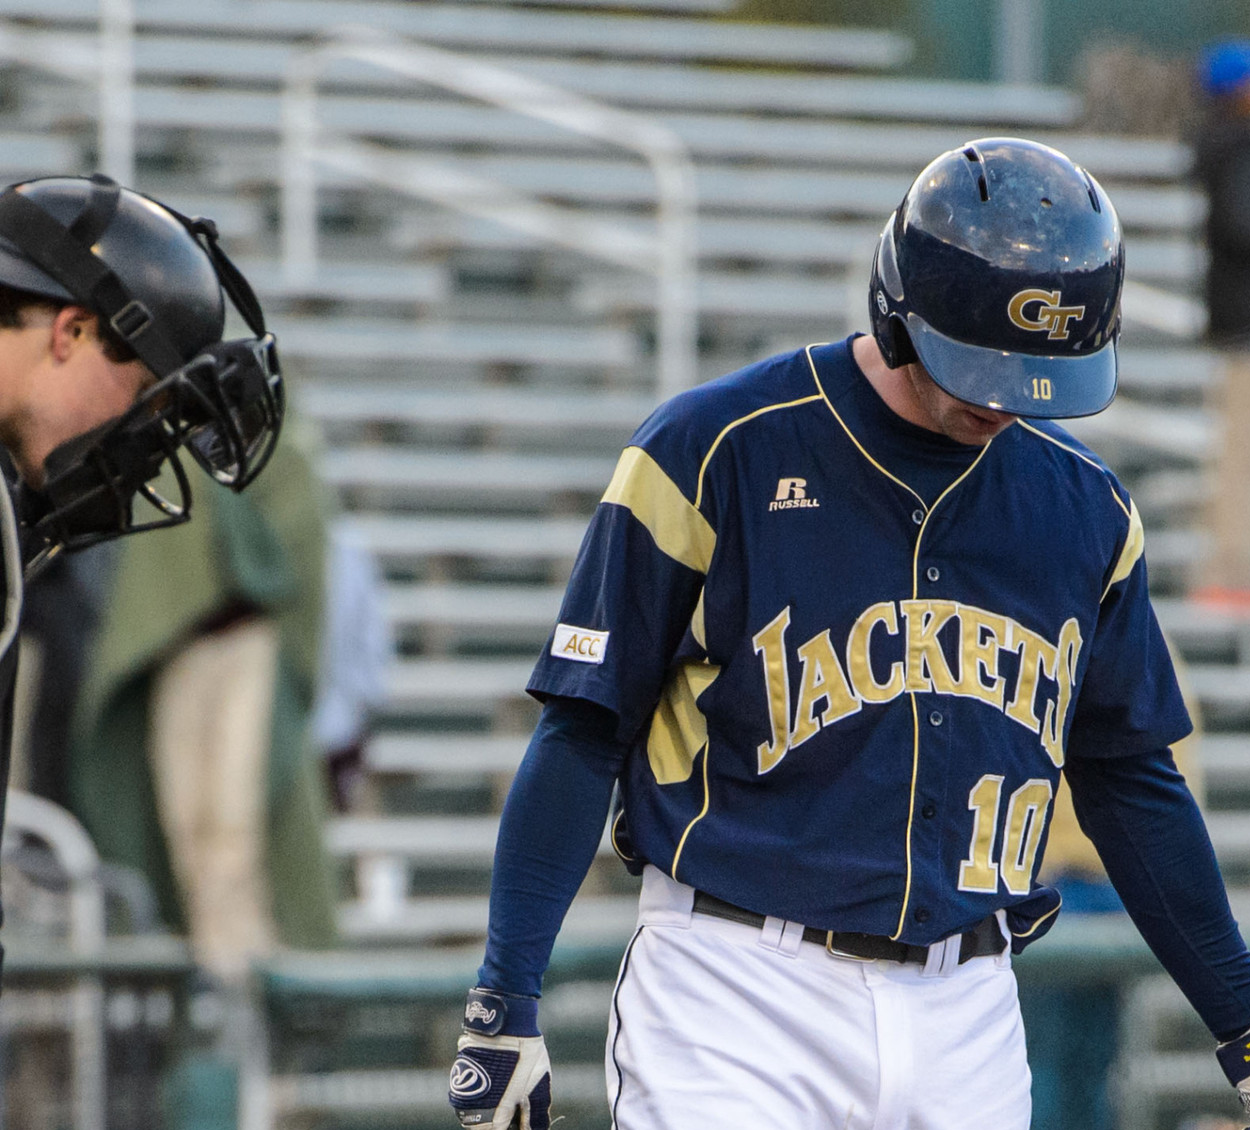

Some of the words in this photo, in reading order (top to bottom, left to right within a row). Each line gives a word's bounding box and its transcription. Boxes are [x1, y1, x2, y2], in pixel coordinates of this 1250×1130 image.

[1007, 288, 1086, 340] GT
[1032, 378, 1052, 400] 10
[768, 498, 820, 511] RUSSELL
[563, 633, 601, 656] ACC
[752, 599, 1084, 775] JACKETS
[957, 773, 1053, 895] 10
